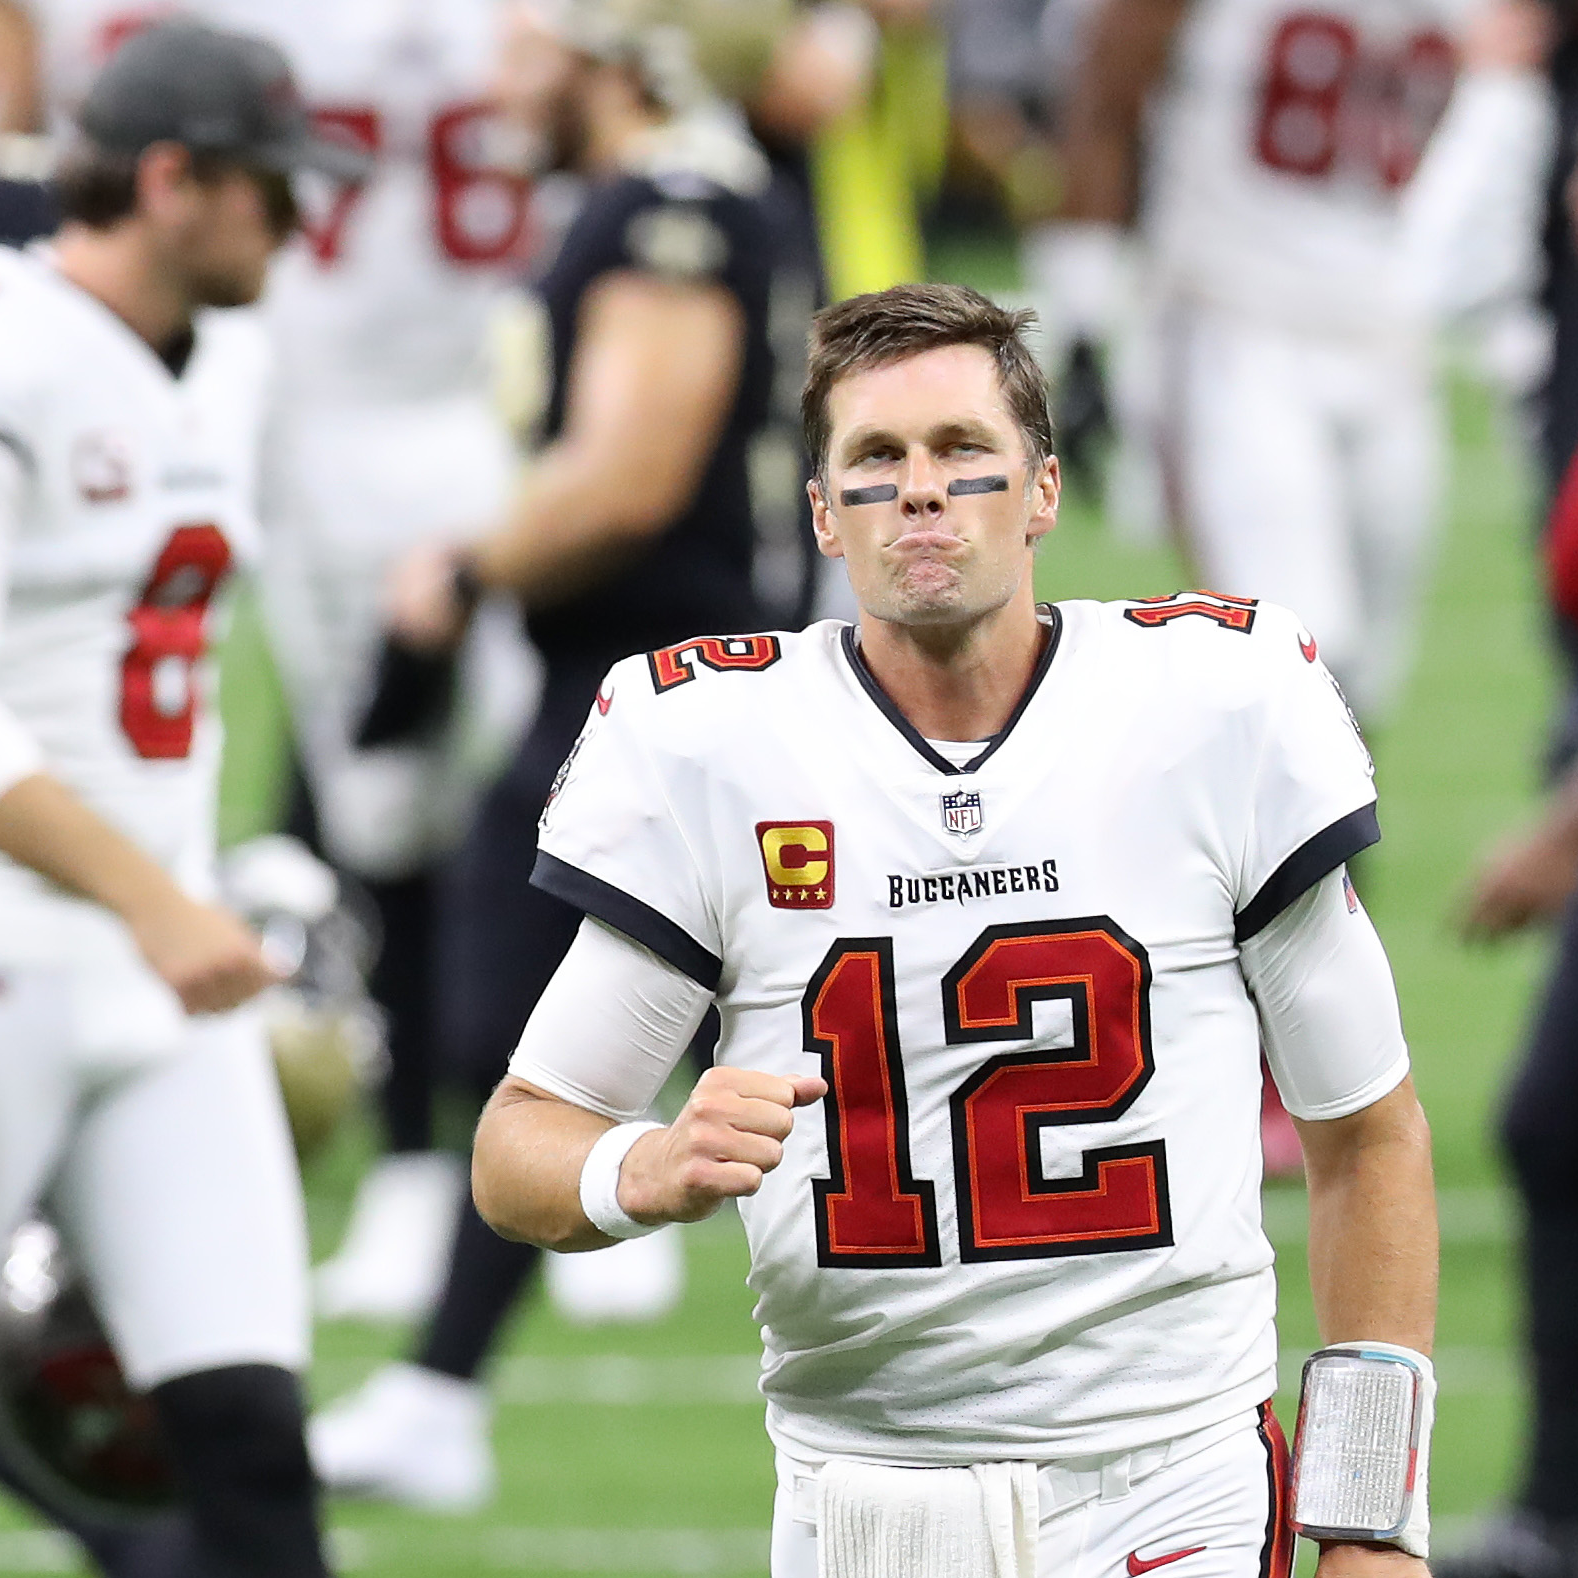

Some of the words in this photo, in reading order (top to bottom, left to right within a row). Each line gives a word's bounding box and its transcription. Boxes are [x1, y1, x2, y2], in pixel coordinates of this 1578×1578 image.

[116, 520, 233, 763] 8
[949, 809, 978, 829] NFL
[762, 826, 828, 886] C
[887, 859, 1059, 908] BUCCANEERS
[802, 914, 1174, 1269] 12
